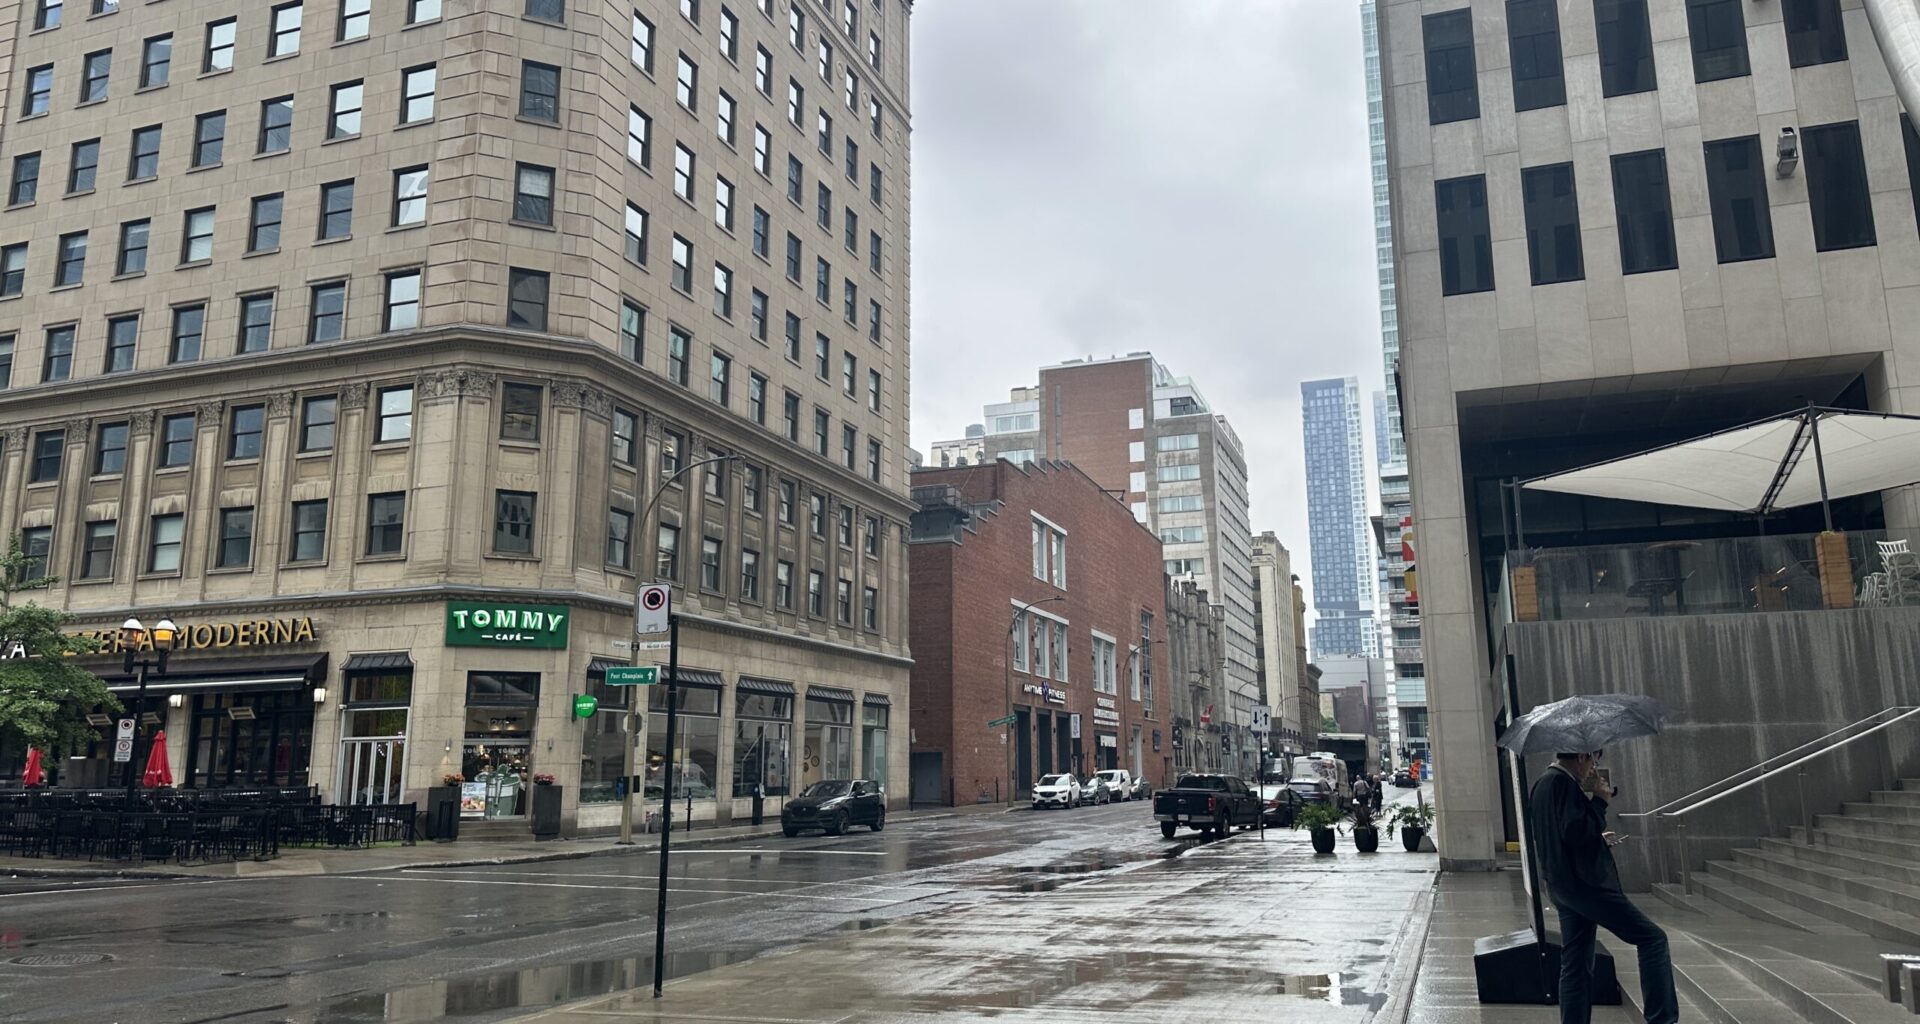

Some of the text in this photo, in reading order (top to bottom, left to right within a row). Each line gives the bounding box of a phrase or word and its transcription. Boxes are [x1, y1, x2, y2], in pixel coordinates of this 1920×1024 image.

[453, 609, 563, 632] TOMMY
[175, 616, 314, 649] MODERNA
[495, 633, 521, 641] CAFÉ
[1024, 684, 1042, 695] ANYTIME
